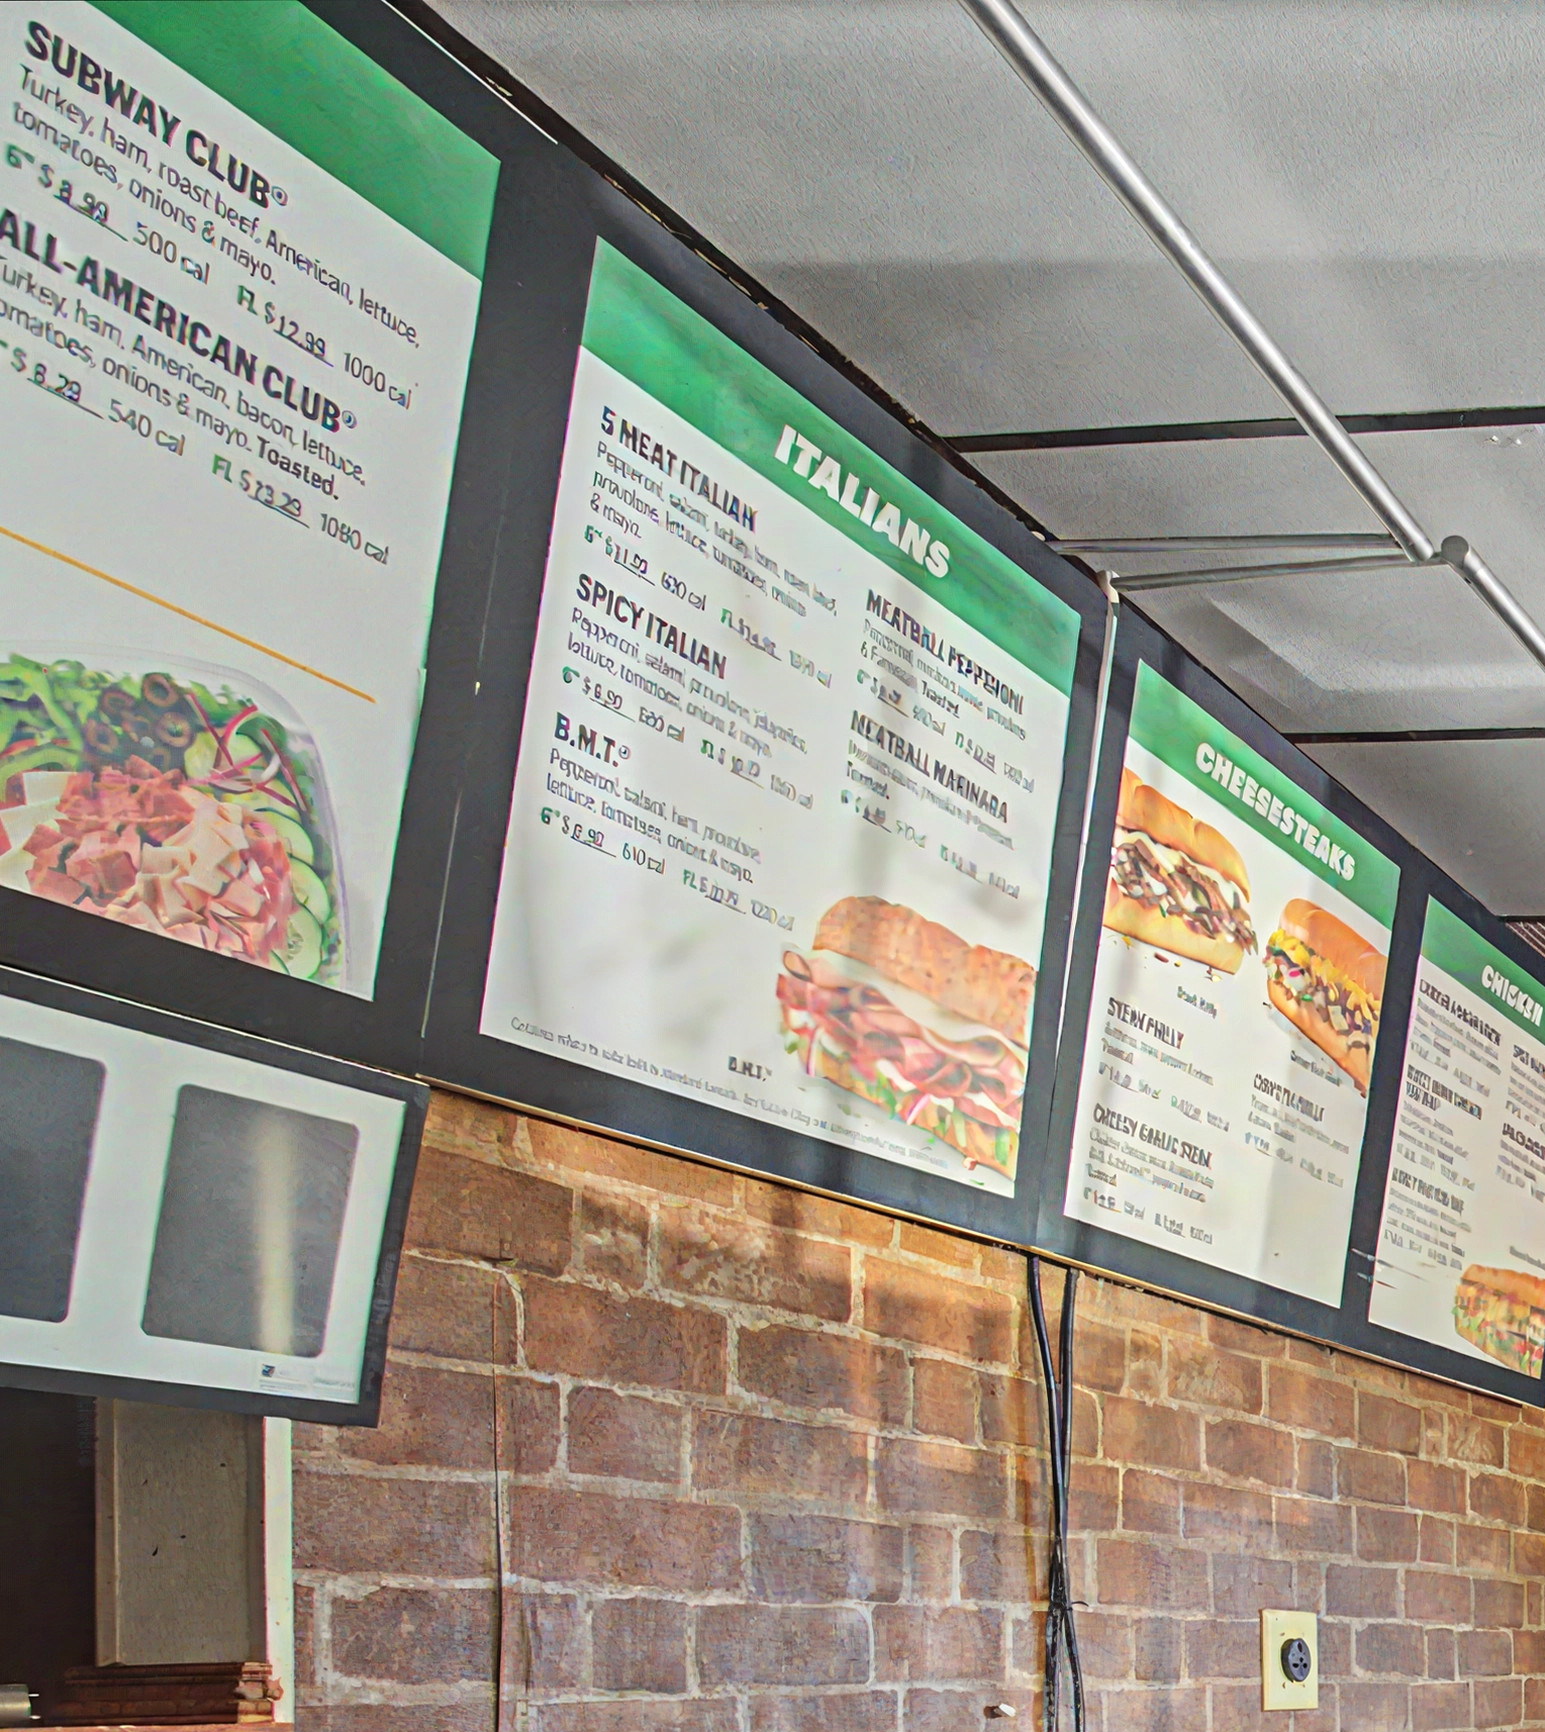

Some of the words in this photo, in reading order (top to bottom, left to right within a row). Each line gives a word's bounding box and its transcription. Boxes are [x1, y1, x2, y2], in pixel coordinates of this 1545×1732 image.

[25, 20, 181, 147] SUBWAY
[13, 101, 124, 191] tomatoes,
[129, 178, 197, 234] onions
[201, 220, 216, 248] &
[219, 236, 276, 285] mayo.
[100, 117, 152, 173] ham,
[159, 161, 211, 210] roast
[0, 207, 259, 386] ALL-AMERICAN
[133, 221, 178, 263] 500
[180, 256, 210, 285] cal
[343, 352, 386, 393] 1000
[389, 385, 412, 410] cal
[0, 299, 96, 368] omatoes,
[102, 357, 172, 408] onions
[176, 392, 191, 416] &
[196, 407, 252, 453] mayo.
[256, 435, 339, 500] Toasted.
[108, 398, 153, 438] 540
[155, 430, 186, 457] cal
[320, 513, 362, 550] 1080
[364, 541, 389, 565] cal
[601, 405, 618, 435] 5
[618, 418, 677, 478] MEAT
[679, 459, 759, 534] ITALIAN
[773, 423, 951, 580] ITALIANS
[576, 572, 645, 631] SPICY
[645, 611, 727, 680] ITALIAN
[865, 588, 945, 663] MEATBALL
[1195, 742, 1355, 881] CHEESESTEAKS
[1481, 964, 1544, 1027] CHICKEN
